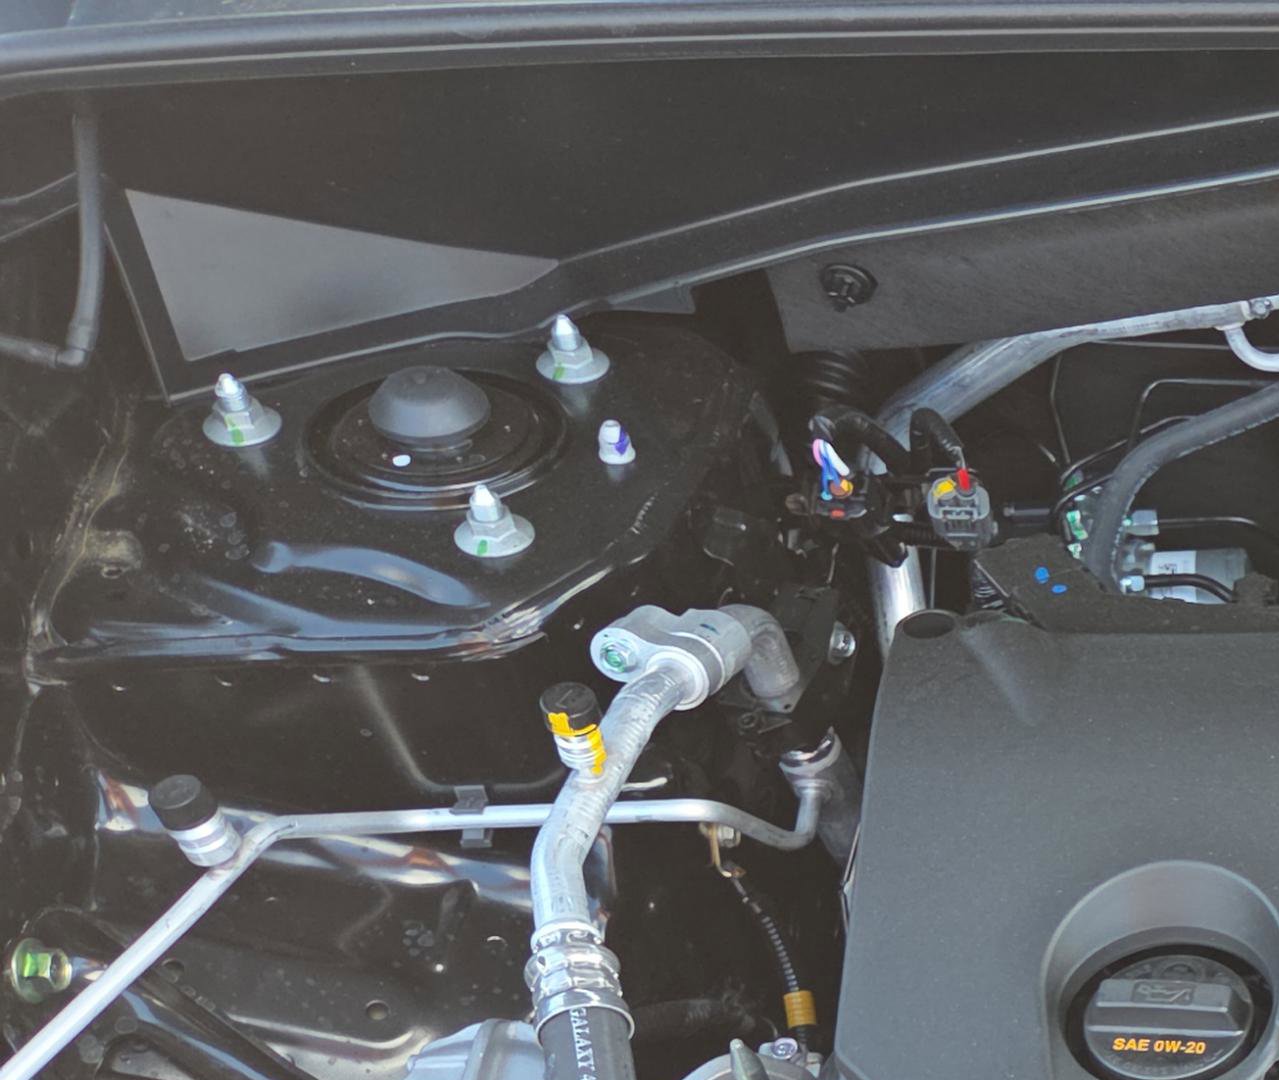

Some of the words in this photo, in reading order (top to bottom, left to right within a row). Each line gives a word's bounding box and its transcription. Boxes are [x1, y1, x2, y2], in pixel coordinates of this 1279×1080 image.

[570, 1008, 593, 1071] GALAXY
[1112, 1037, 1150, 1052] SAE
[1153, 1040, 1206, 1055] 0W-20
